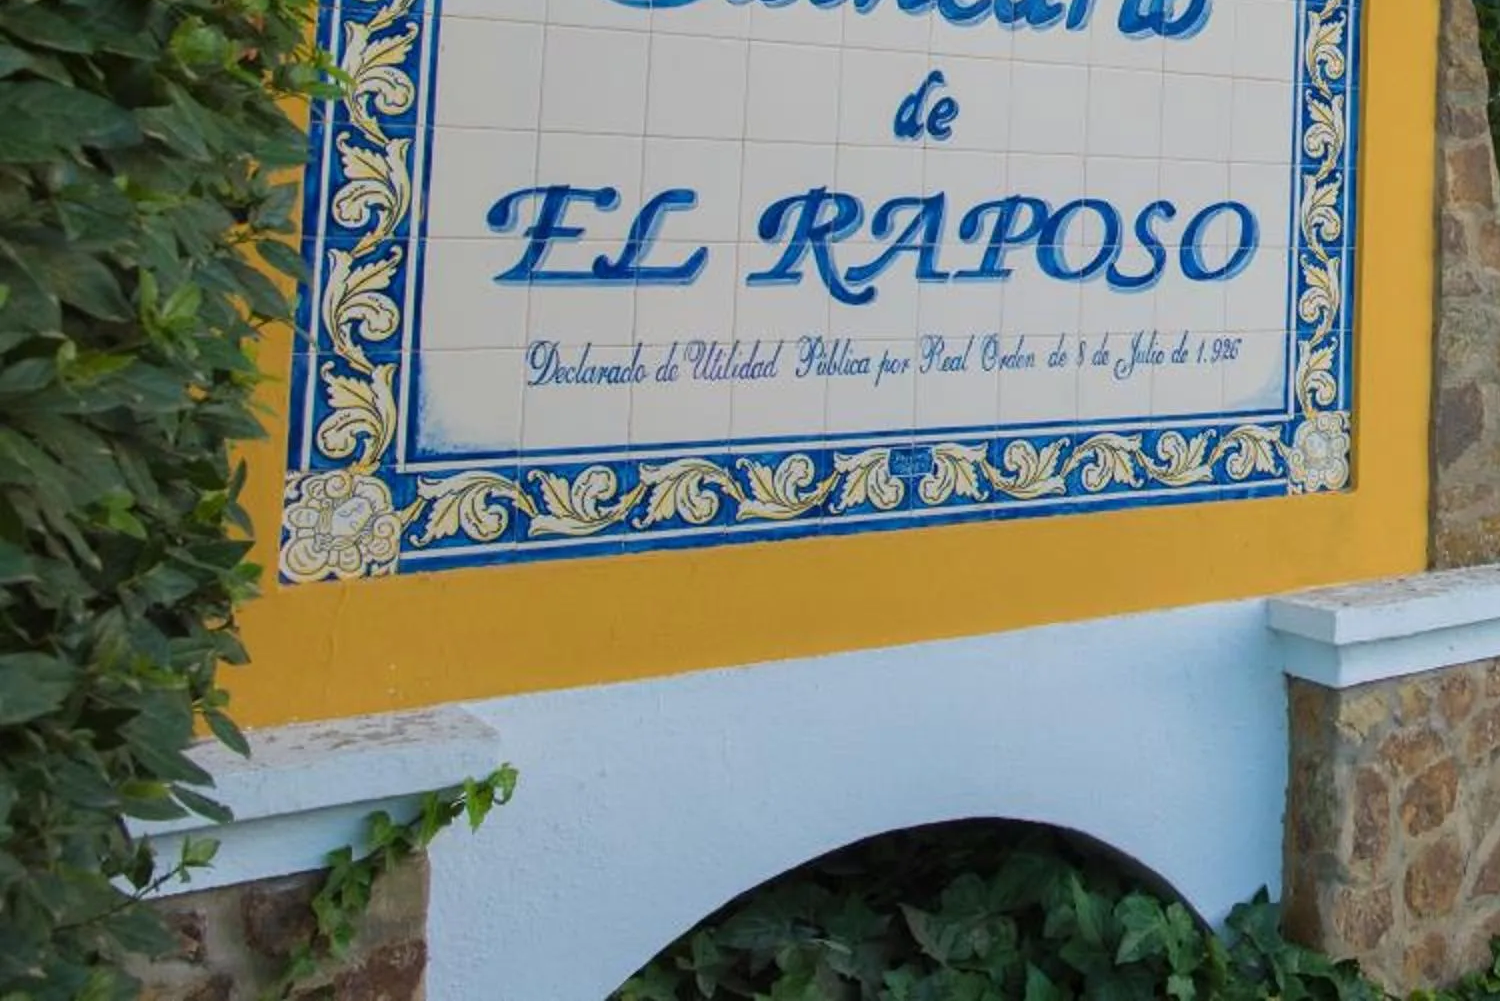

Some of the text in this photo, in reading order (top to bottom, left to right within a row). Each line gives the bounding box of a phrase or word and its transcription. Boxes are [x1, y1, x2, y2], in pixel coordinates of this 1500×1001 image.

[891, 69, 960, 142] de
[485, 183, 1261, 307] EL RAPOSO
[525, 339, 646, 387] Declarado
[655, 341, 679, 383] de
[683, 338, 784, 384] Utilidad
[873, 349, 911, 388] por
[919, 334, 976, 375] Real
[980, 332, 1035, 372] Orden
[1047, 332, 1067, 368] de
[1092, 331, 1110, 366] de
[1113, 329, 1165, 381] Julio
[1171, 329, 1190, 364] de
